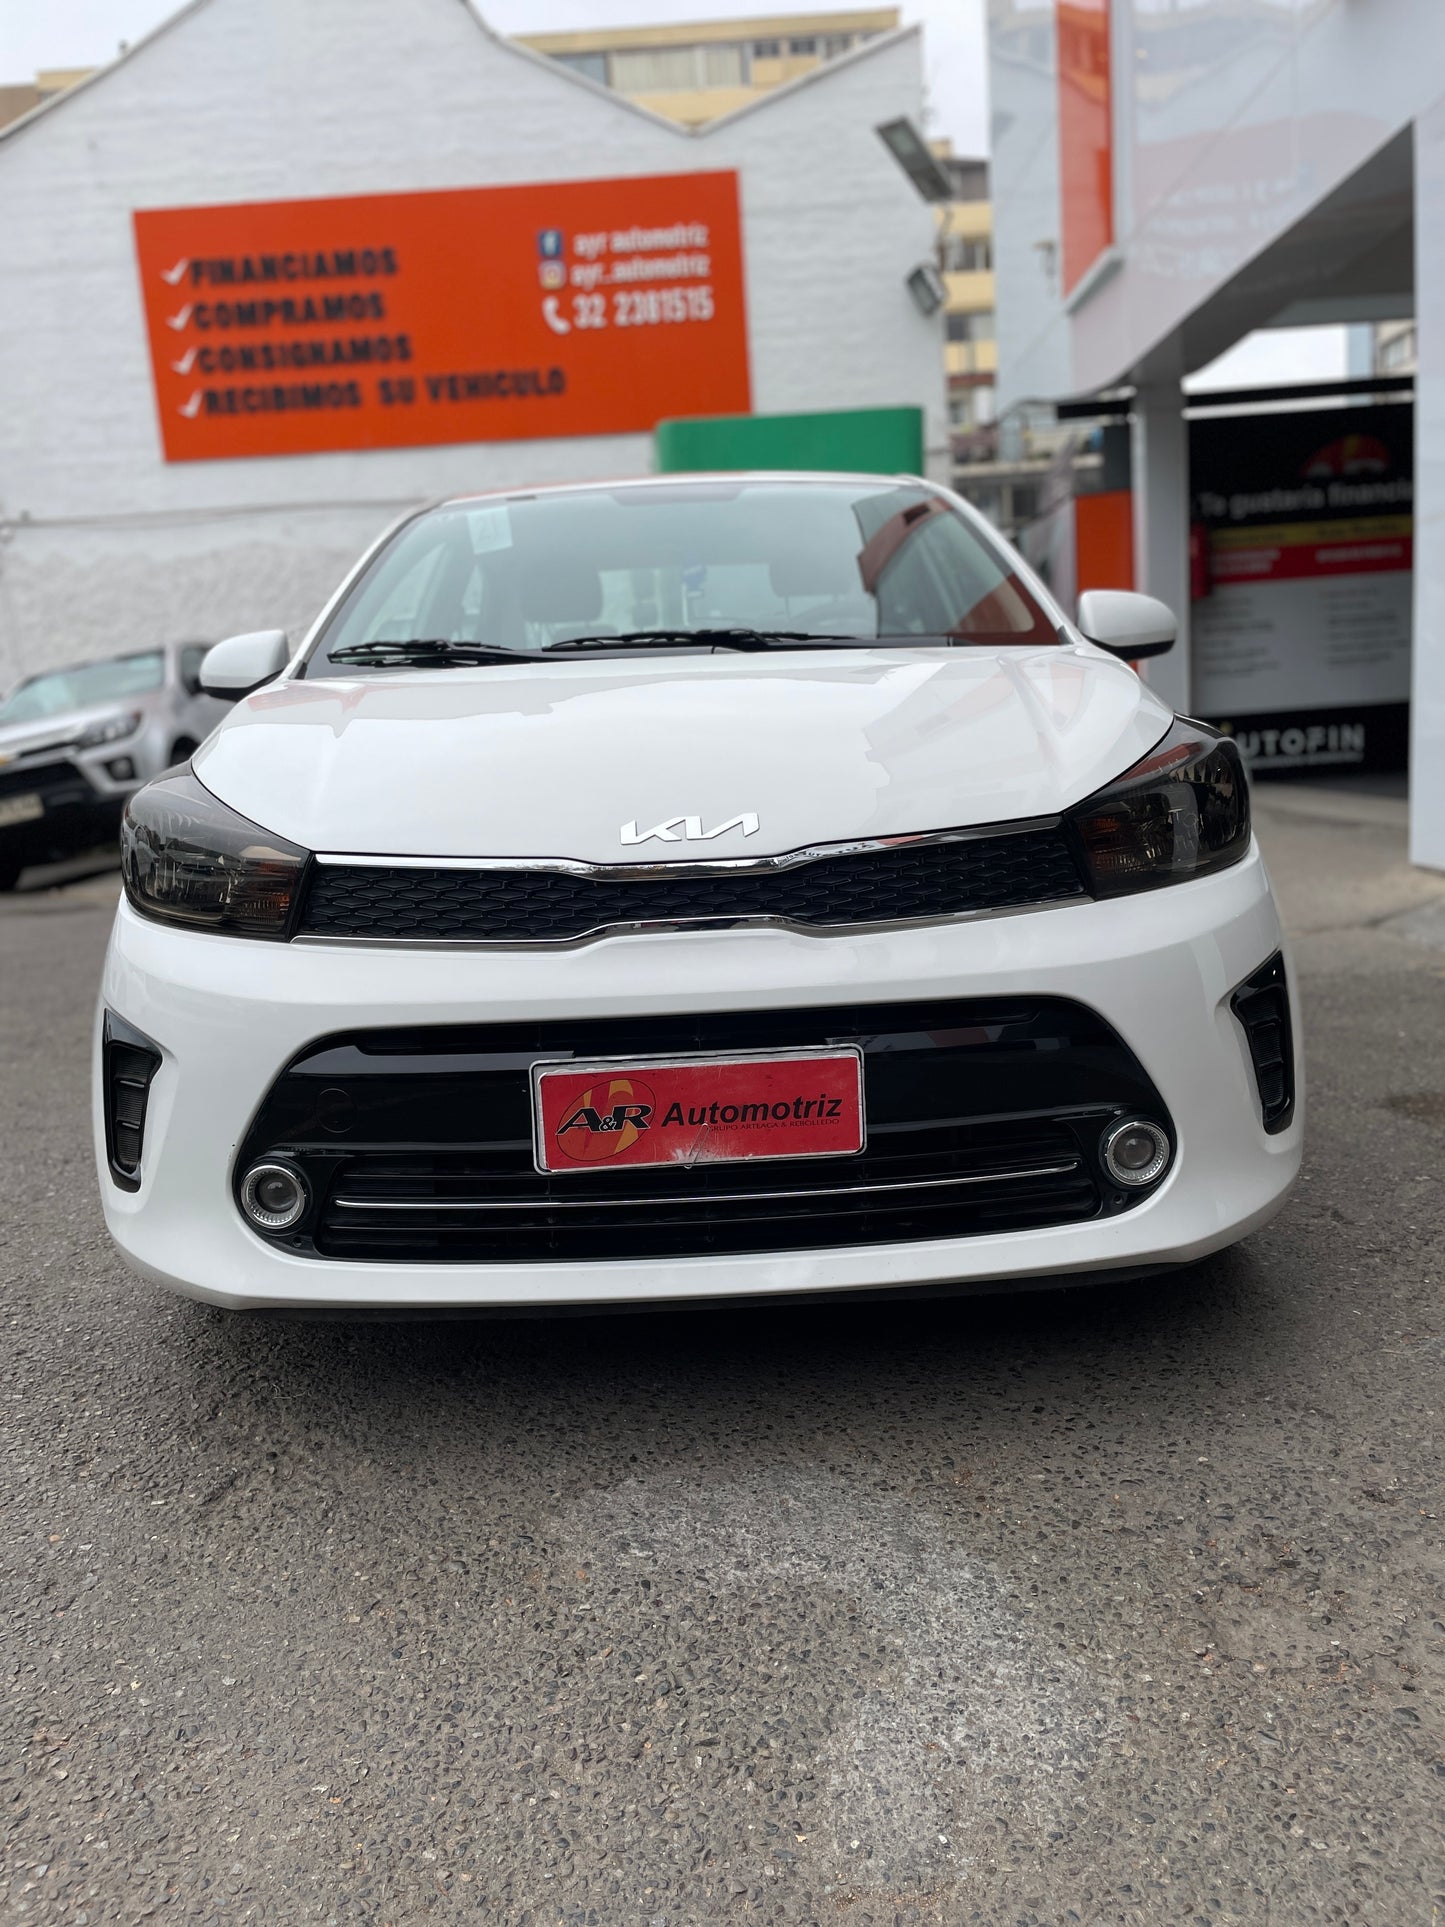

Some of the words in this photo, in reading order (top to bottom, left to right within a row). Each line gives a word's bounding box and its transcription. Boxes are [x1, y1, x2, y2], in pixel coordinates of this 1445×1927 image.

[610, 222, 709, 253] automotriz
[192, 248, 397, 287] FINANCIAMOS
[195, 292, 385, 329] COMPRAMOS
[573, 293, 606, 329] 32
[199, 334, 412, 374] CONSIGNAMOS
[205, 382, 361, 415] RECIBIMOS
[379, 378, 415, 404] SU
[1236, 723, 1365, 757] UTOFIN
[620, 812, 760, 845] KIA
[661, 1093, 843, 1128] Automotriz
